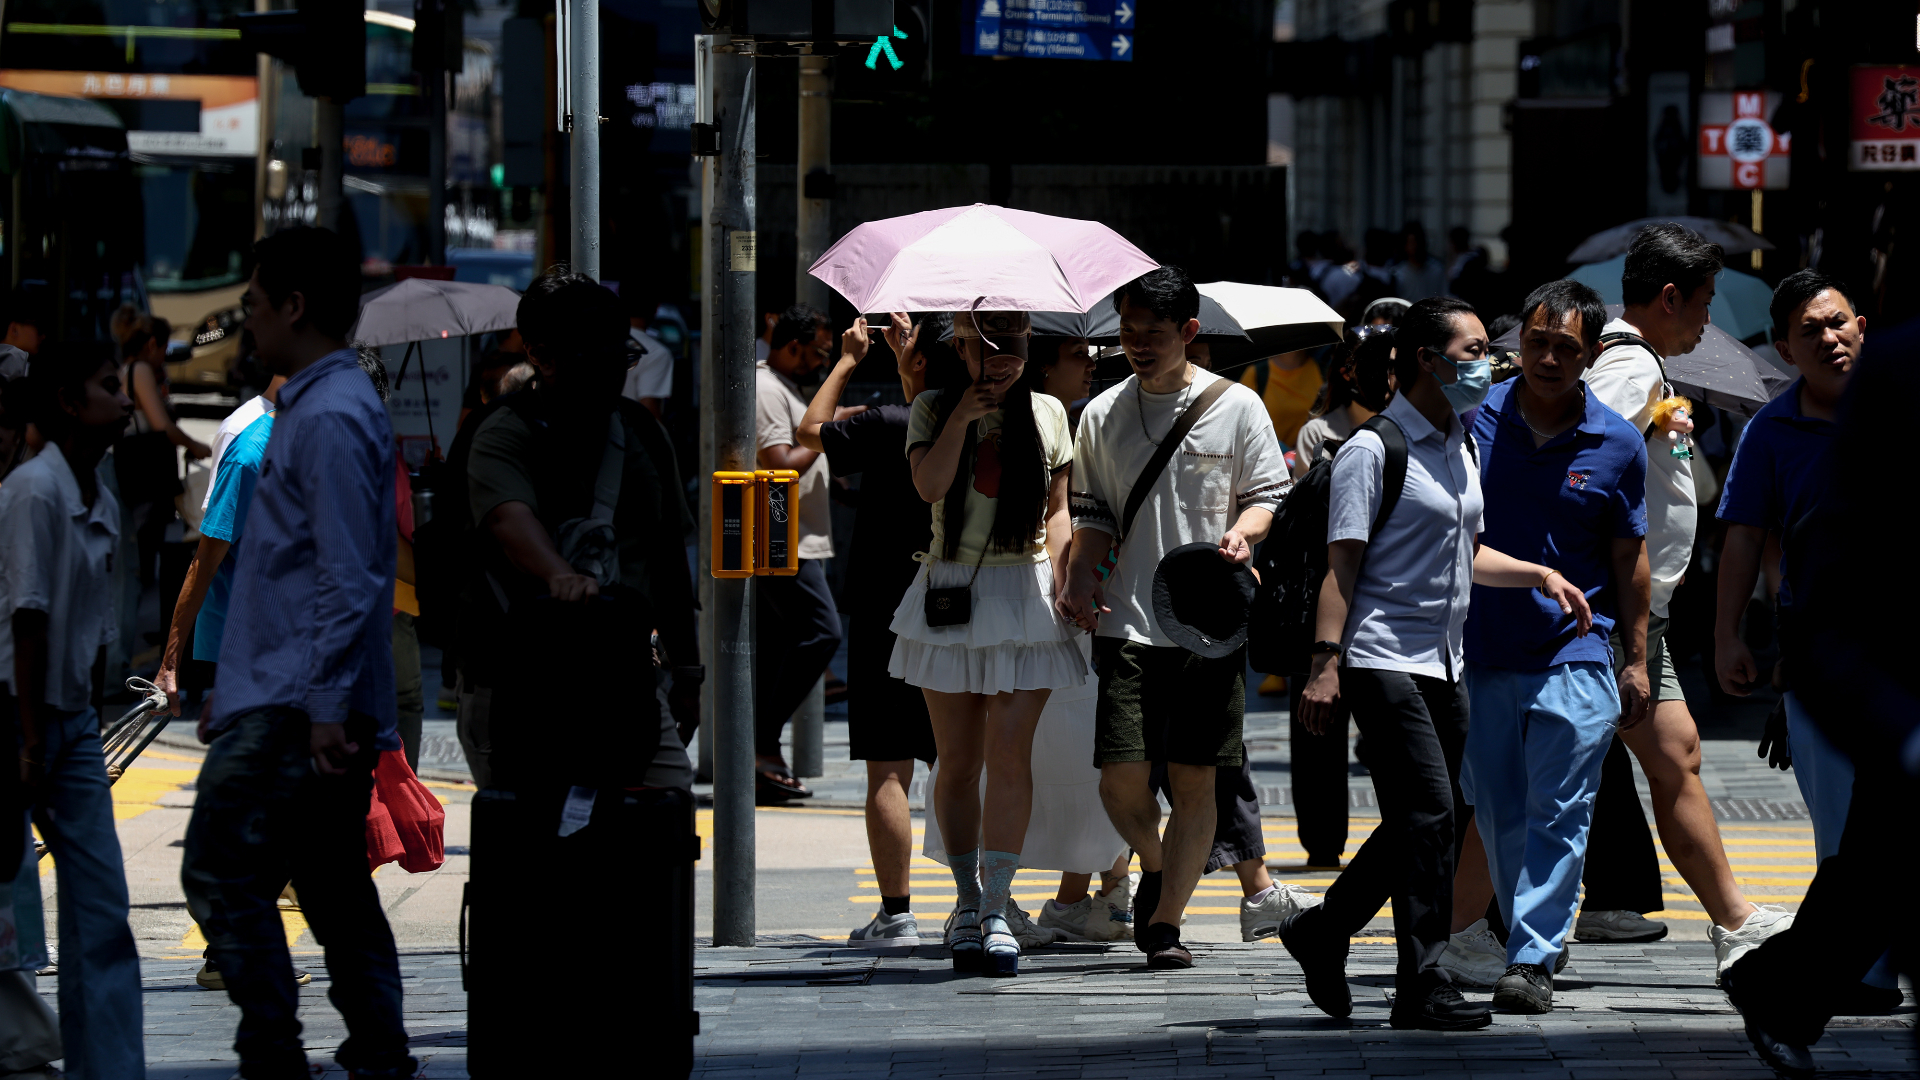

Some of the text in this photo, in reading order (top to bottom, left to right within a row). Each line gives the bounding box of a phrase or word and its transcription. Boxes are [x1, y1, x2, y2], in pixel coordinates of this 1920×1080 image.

[1004, 9, 1035, 20] Cruise
[1036, 10, 1073, 22] Terminal
[1003, 41, 1021, 52] Star
[1023, 42, 1045, 55] Ferry
[1737, 94, 1761, 116] M
[1705, 129, 1722, 152] T
[1776, 131, 1792, 151] Y
[1737, 164, 1759, 187] C
